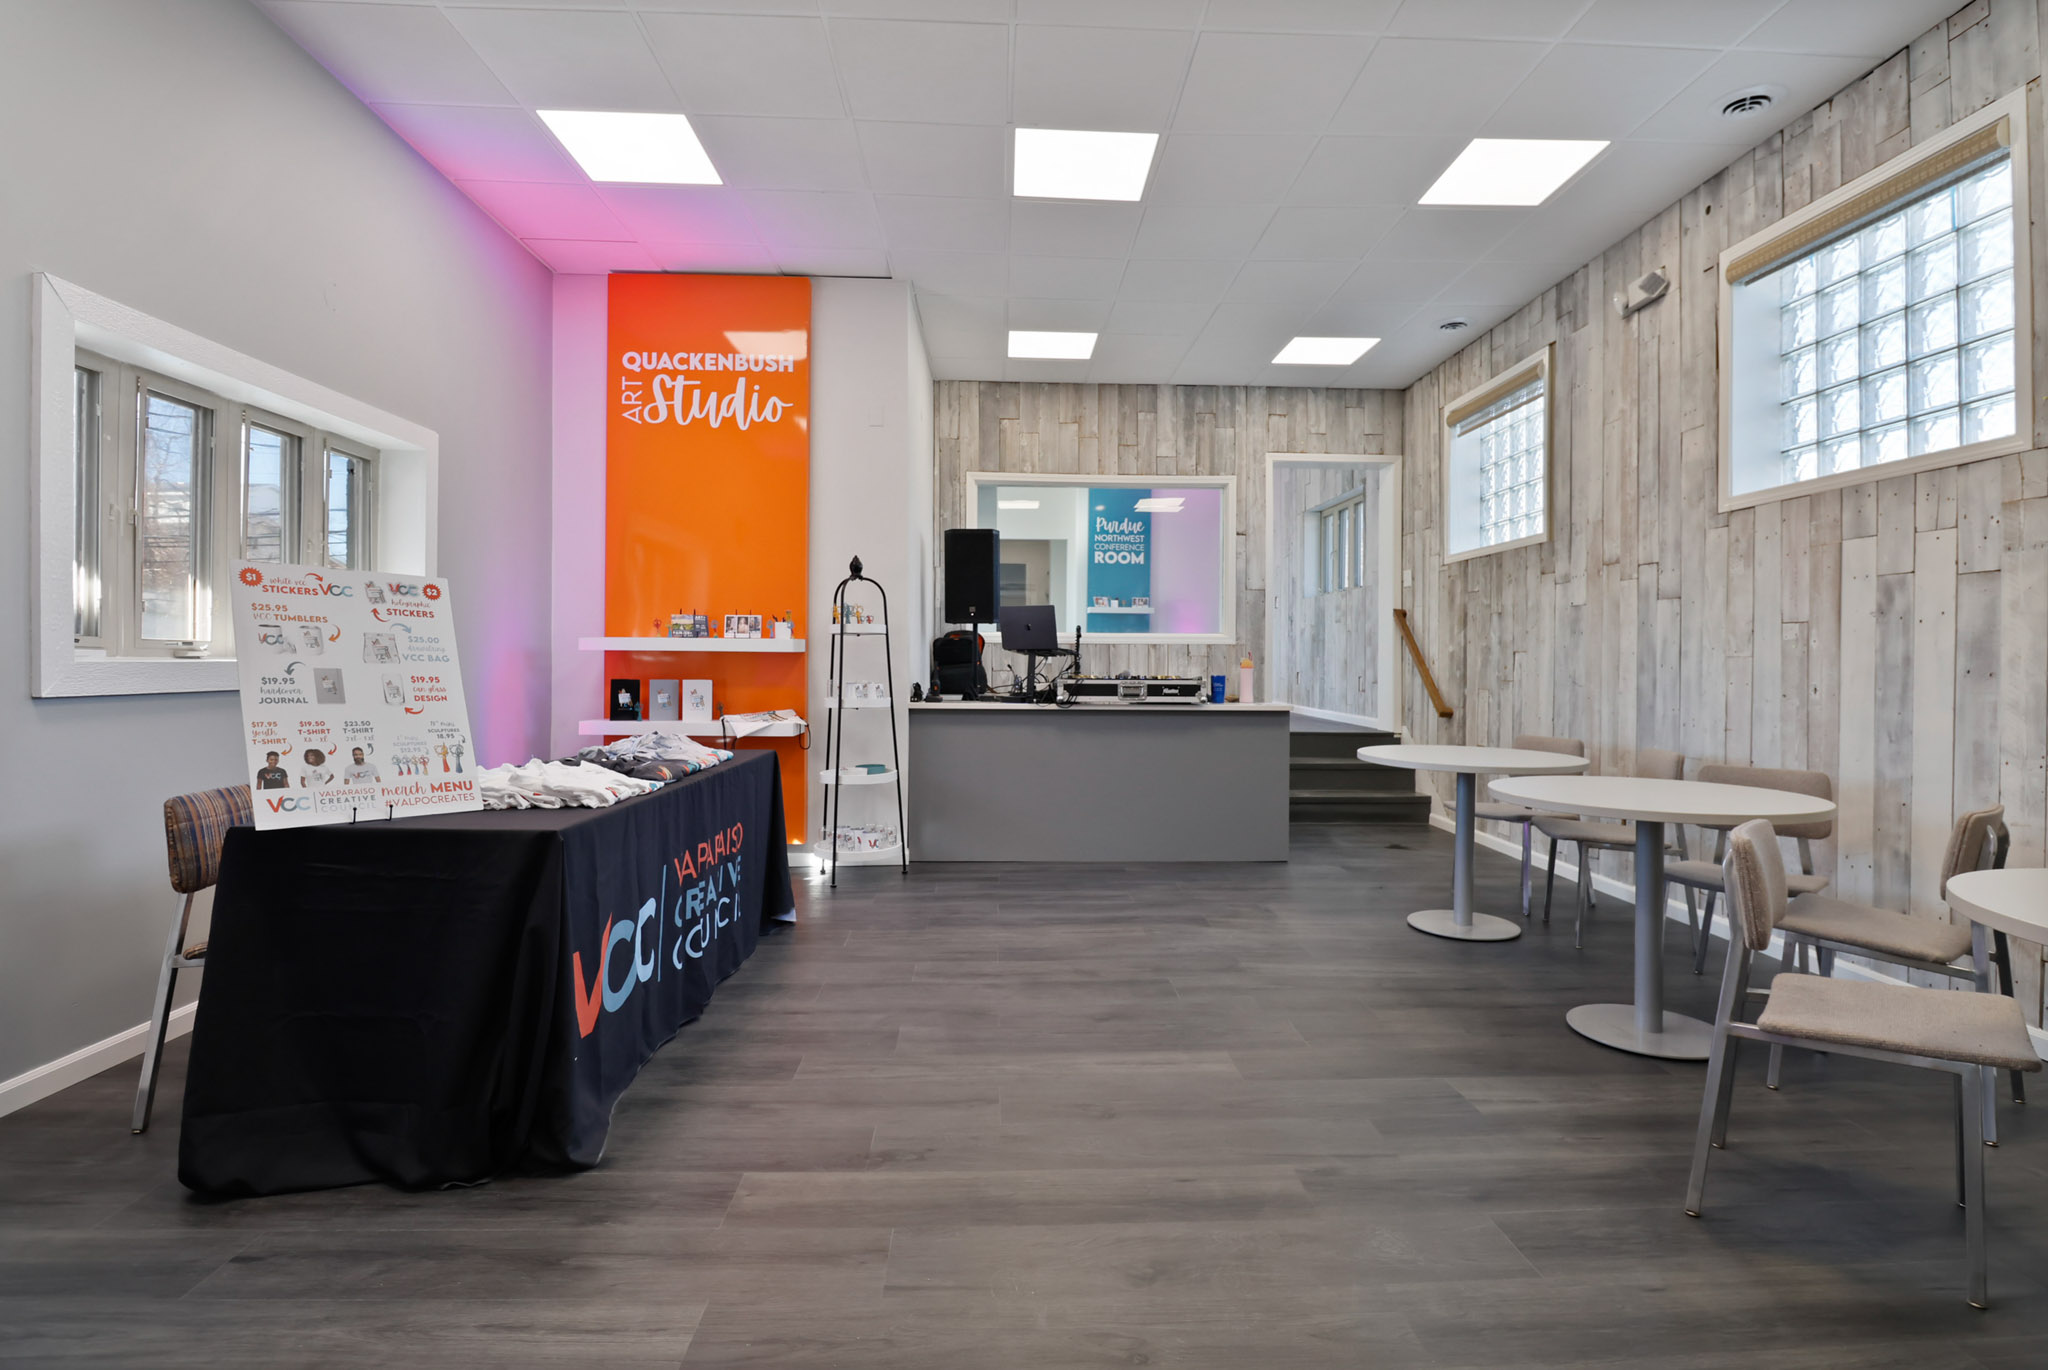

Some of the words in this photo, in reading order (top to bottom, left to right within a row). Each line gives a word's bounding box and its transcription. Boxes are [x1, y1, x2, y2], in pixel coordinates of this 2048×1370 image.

[622, 351, 794, 372] QUACKENBUSH
[622, 376, 642, 424] ART
[643, 373, 794, 430] Studio
[1096, 516, 1145, 534] Purdue
[1094, 534, 1145, 543] NORTHWEST
[1094, 543, 1145, 551] CONFERENCE
[1094, 551, 1145, 564] ROOM
[245, 572, 257, 581] $1
[262, 585, 319, 596] STICKERS
[319, 583, 353, 597] VCC
[388, 583, 419, 597] VCC
[426, 588, 438, 596] $2
[251, 602, 288, 612] $25.95
[273, 613, 328, 623] TUMBLERS
[386, 608, 435, 618] STICKERS
[408, 635, 440, 644] $25.00
[402, 653, 425, 661] VCC
[427, 654, 450, 662] BAG
[261, 676, 295, 685] $19.95
[411, 675, 440, 684] $19.95
[260, 686, 302, 695] hardcover
[319, 787, 376, 797] VALPARAISO
[381, 781, 426, 797] merch
[430, 780, 473, 794] MENU
[265, 795, 311, 813] VCC
[320, 795, 376, 805] CREATIVE
[384, 793, 476, 807] #VALPOCREATES
[674, 822, 743, 887] VAPAAISO
[674, 855, 742, 928] CREAIVE
[572, 897, 656, 1039] VCC
